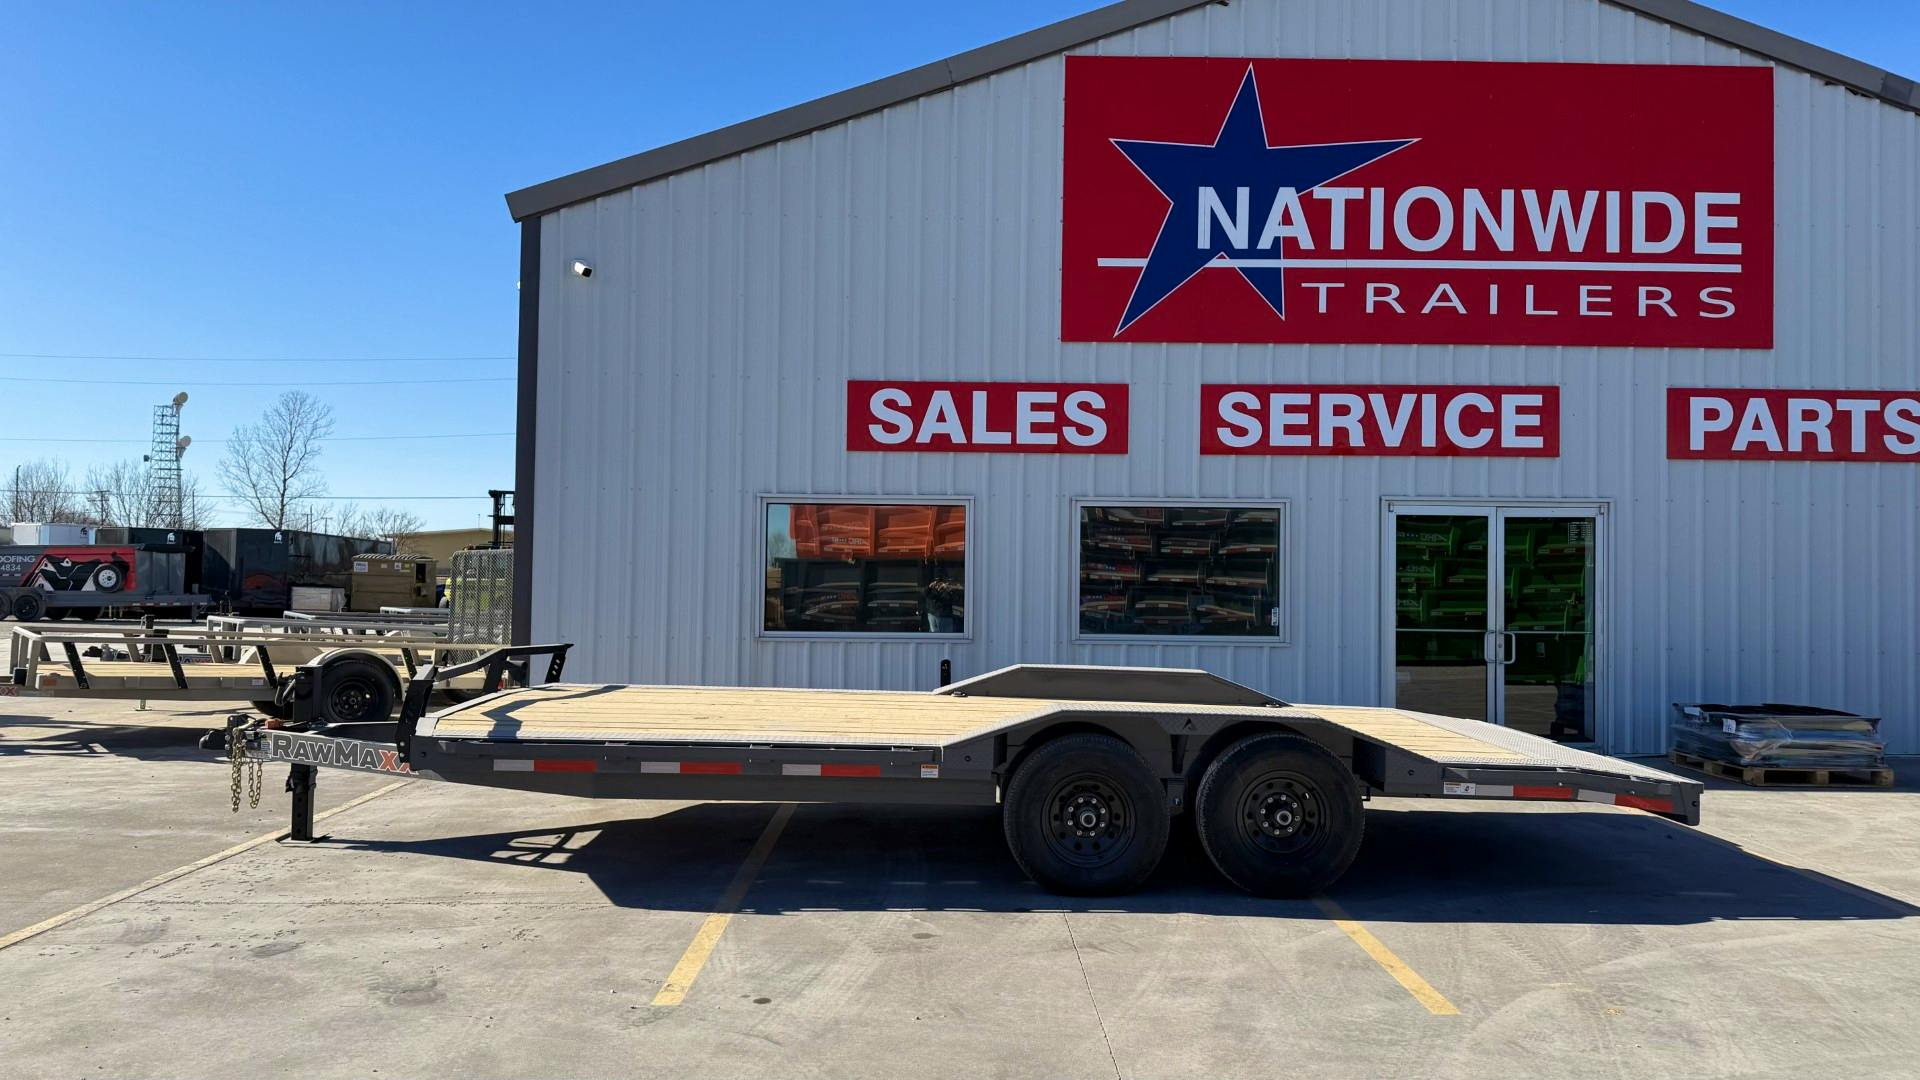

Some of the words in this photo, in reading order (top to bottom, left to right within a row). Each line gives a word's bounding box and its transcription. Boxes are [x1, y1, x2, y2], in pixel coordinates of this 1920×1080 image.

[1196, 186, 1742, 255] NATIONWIDE
[1302, 282, 1737, 318] TRAILERS
[868, 389, 1107, 445] SALES
[1216, 391, 1543, 448] SERVICE
[1689, 397, 1920, 454] PARTS
